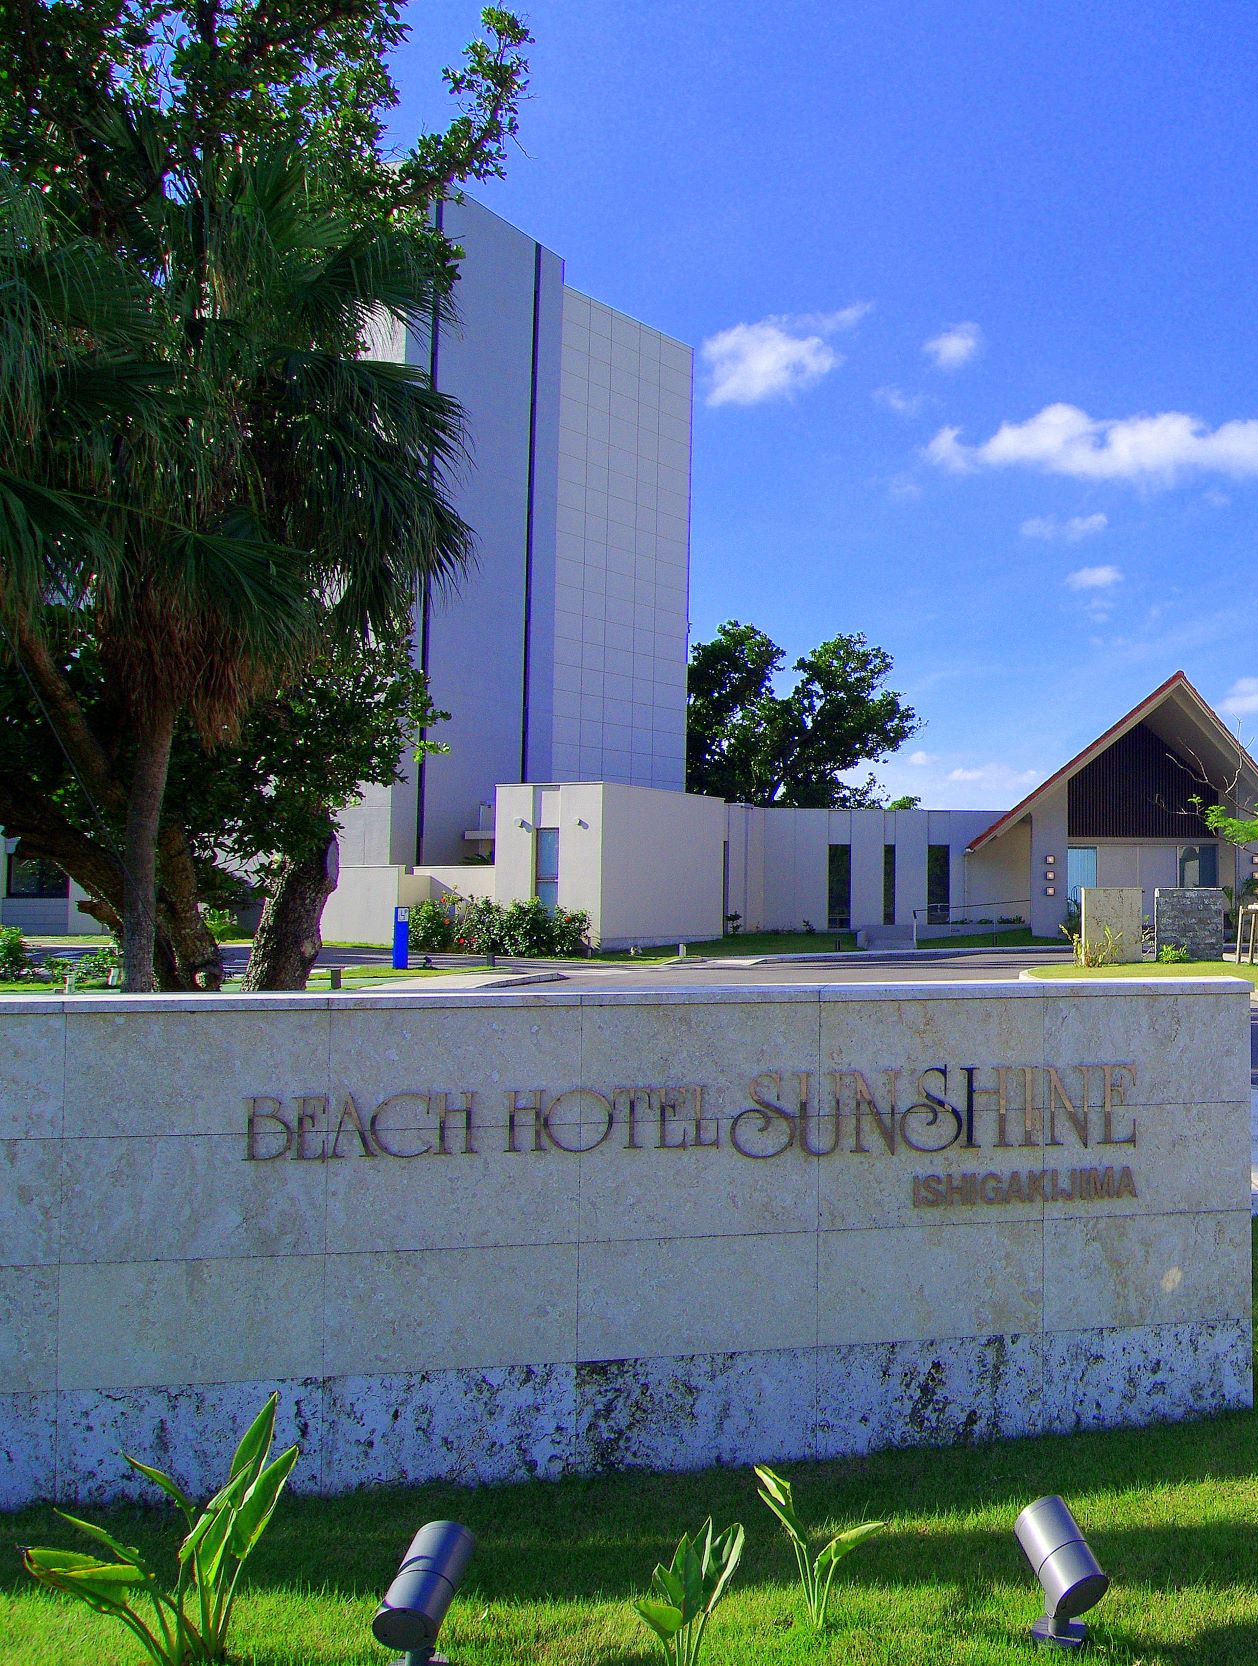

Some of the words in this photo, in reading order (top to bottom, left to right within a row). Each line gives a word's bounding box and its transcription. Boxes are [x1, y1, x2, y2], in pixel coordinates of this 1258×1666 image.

[242, 1091, 477, 1162] BEACH
[503, 1085, 719, 1153] HOTEL
[730, 1064, 1137, 1158] SUNSHINE
[913, 1165, 1137, 1208] ISHIGAKIJIMA
